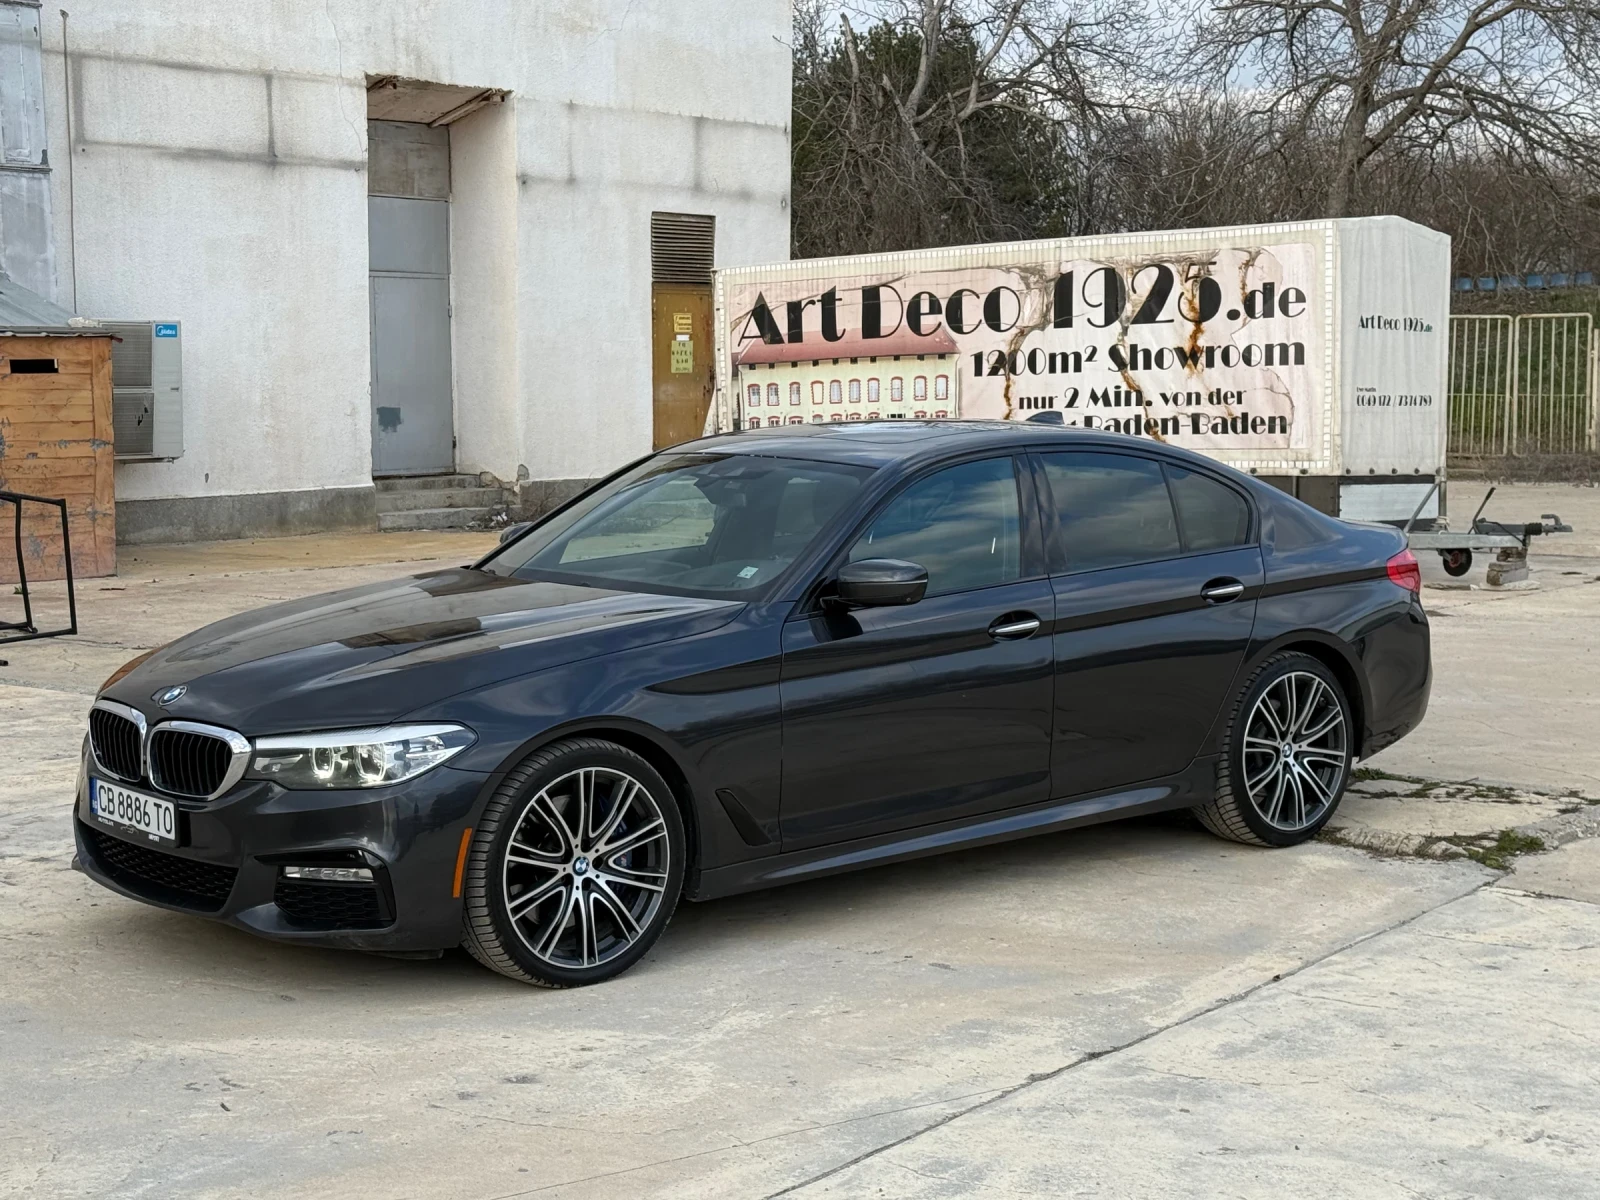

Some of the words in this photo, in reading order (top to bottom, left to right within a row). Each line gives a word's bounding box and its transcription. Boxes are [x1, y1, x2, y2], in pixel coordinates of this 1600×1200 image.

[738, 285, 846, 347] Art
[862, 284, 1021, 339] Deco
[1053, 261, 1306, 329] 1925.de
[1358, 315, 1375, 329] Art
[1377, 315, 1400, 330] Deco
[1403, 317, 1433, 332] 1925.de
[1108, 342, 1305, 373] Showroom
[1019, 395, 1058, 409] nur
[1064, 387, 1079, 409] 2
[1086, 385, 1153, 409] Min.
[1159, 391, 1201, 407] von
[1208, 388, 1247, 406] der
[1378, 395, 1391, 406] 172
[98, 784, 115, 815] CB
[118, 792, 150, 827] 8886
